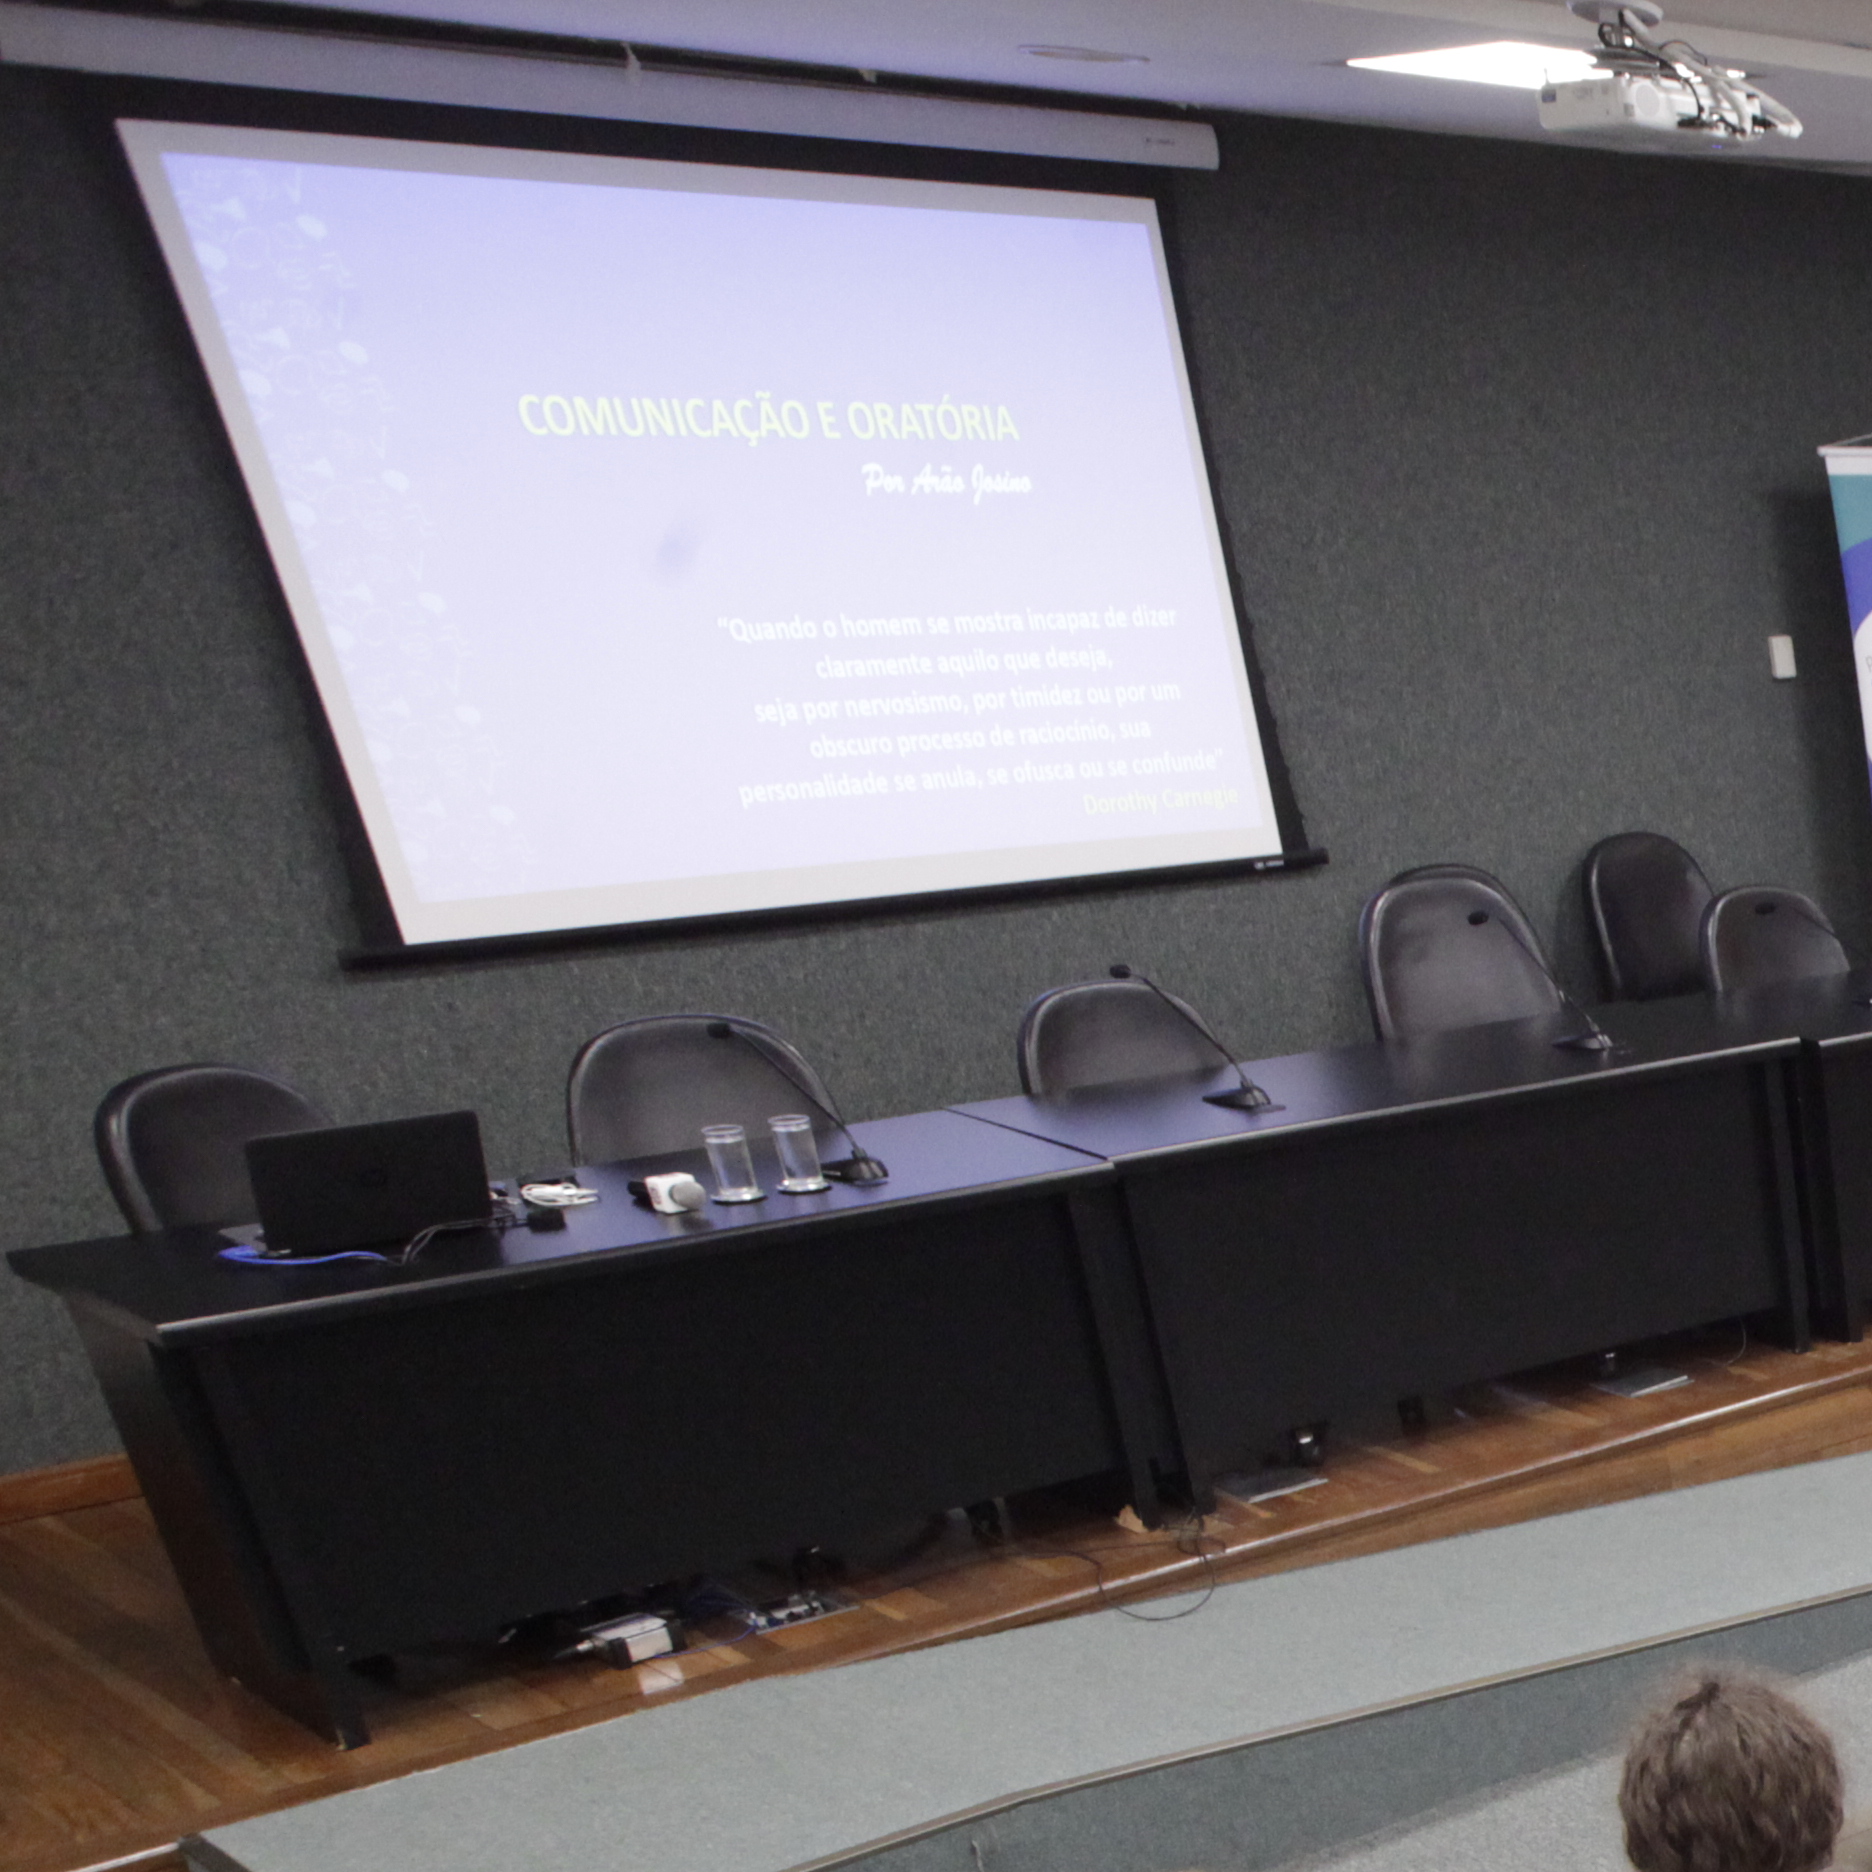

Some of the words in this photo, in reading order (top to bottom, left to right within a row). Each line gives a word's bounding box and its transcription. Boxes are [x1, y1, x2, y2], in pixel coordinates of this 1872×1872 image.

[518, 389, 810, 447] COMUNICAÇÃO
[817, 401, 841, 440] E
[847, 394, 1020, 441] ORATÓRIA
[862, 461, 905, 496] Por
[911, 463, 965, 496] Arão
[824, 619, 838, 638] o
[842, 613, 919, 637] homem
[927, 617, 949, 635] se
[955, 613, 1023, 634] mostra
[1028, 608, 1098, 635] incapaz
[1105, 607, 1127, 628] de
[1132, 604, 1177, 628] dizer
[816, 655, 933, 679] claramente
[938, 649, 998, 679] aquilo
[1004, 652, 1041, 677] que
[1045, 644, 1114, 675] deseja,
[755, 697, 799, 728] seja
[803, 699, 838, 725] por
[844, 692, 968, 720] nervosismo,
[974, 691, 1006, 715] por
[1011, 684, 1082, 710] timidez
[1087, 686, 1111, 704] ou
[1116, 683, 1146, 706] por
[1151, 681, 1180, 700] um
[810, 735, 892, 759] obscuro
[898, 732, 985, 759] processo
[991, 724, 1014, 747] de
[1121, 720, 1151, 738] sua
[738, 774, 888, 809] personalidade
[894, 773, 916, 792] se
[922, 765, 983, 791] anula,
[987, 767, 1008, 785] se
[1013, 756, 1074, 784] ofusca
[1080, 760, 1104, 778] ou
[1109, 758, 1128, 776] se
